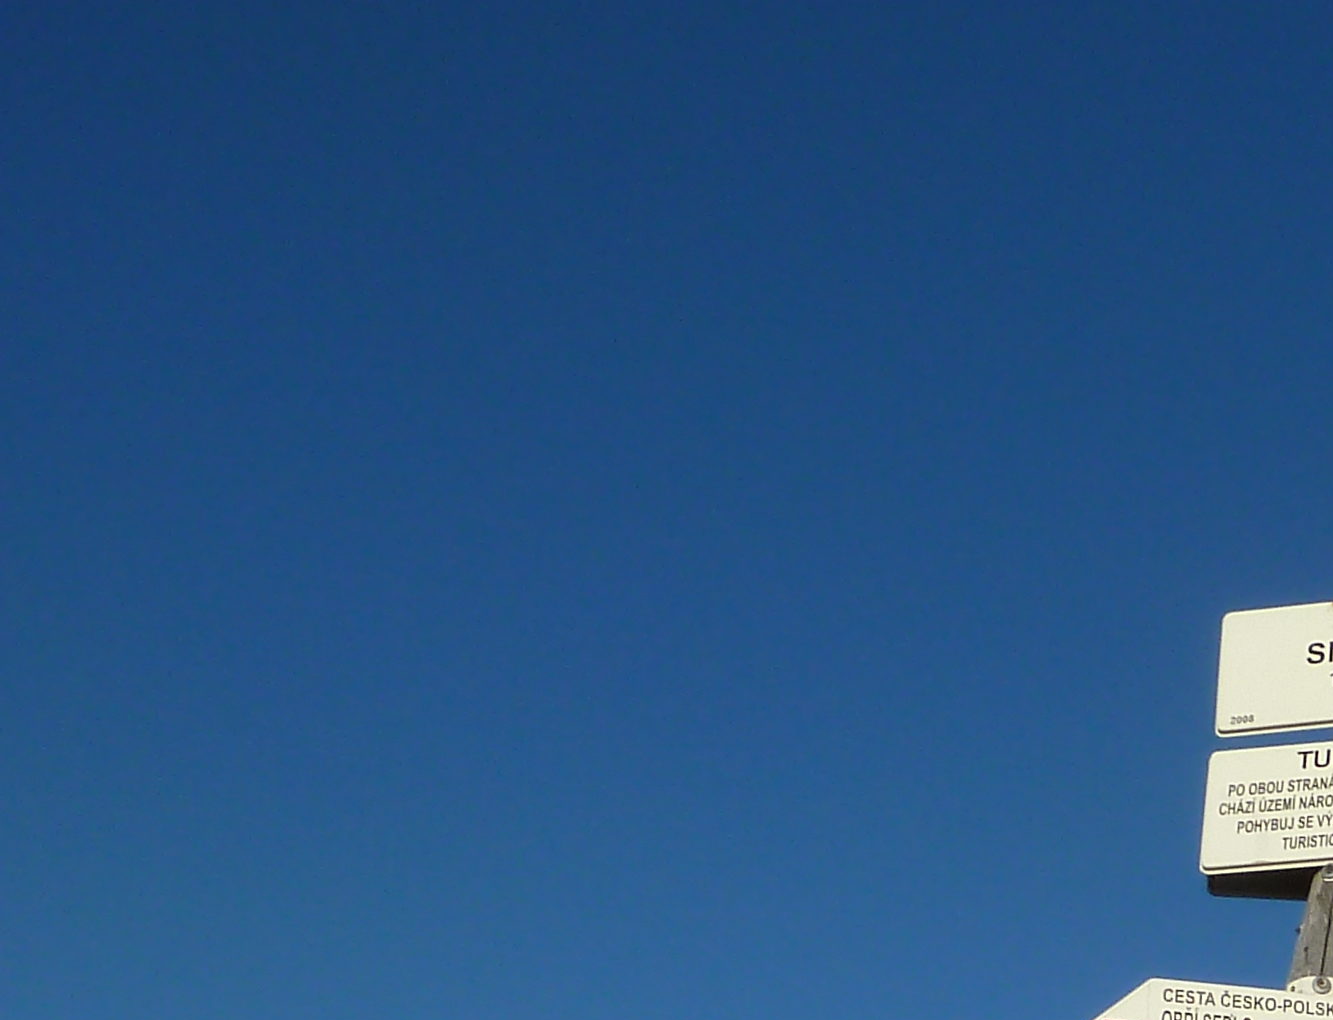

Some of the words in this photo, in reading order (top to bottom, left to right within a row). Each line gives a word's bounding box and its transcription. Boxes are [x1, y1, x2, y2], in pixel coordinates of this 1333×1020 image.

[1230, 715, 1254, 725] 2008
[1228, 784, 1245, 797] PO
[1249, 781, 1284, 795] OBOU
[1219, 799, 1255, 815] CHÁZÍ
[1259, 795, 1295, 812] ÚZEMÍ
[1237, 818, 1294, 834] POHYBUJ
[1298, 816, 1313, 829] SE
[1163, 989, 1215, 1007] CESTA
